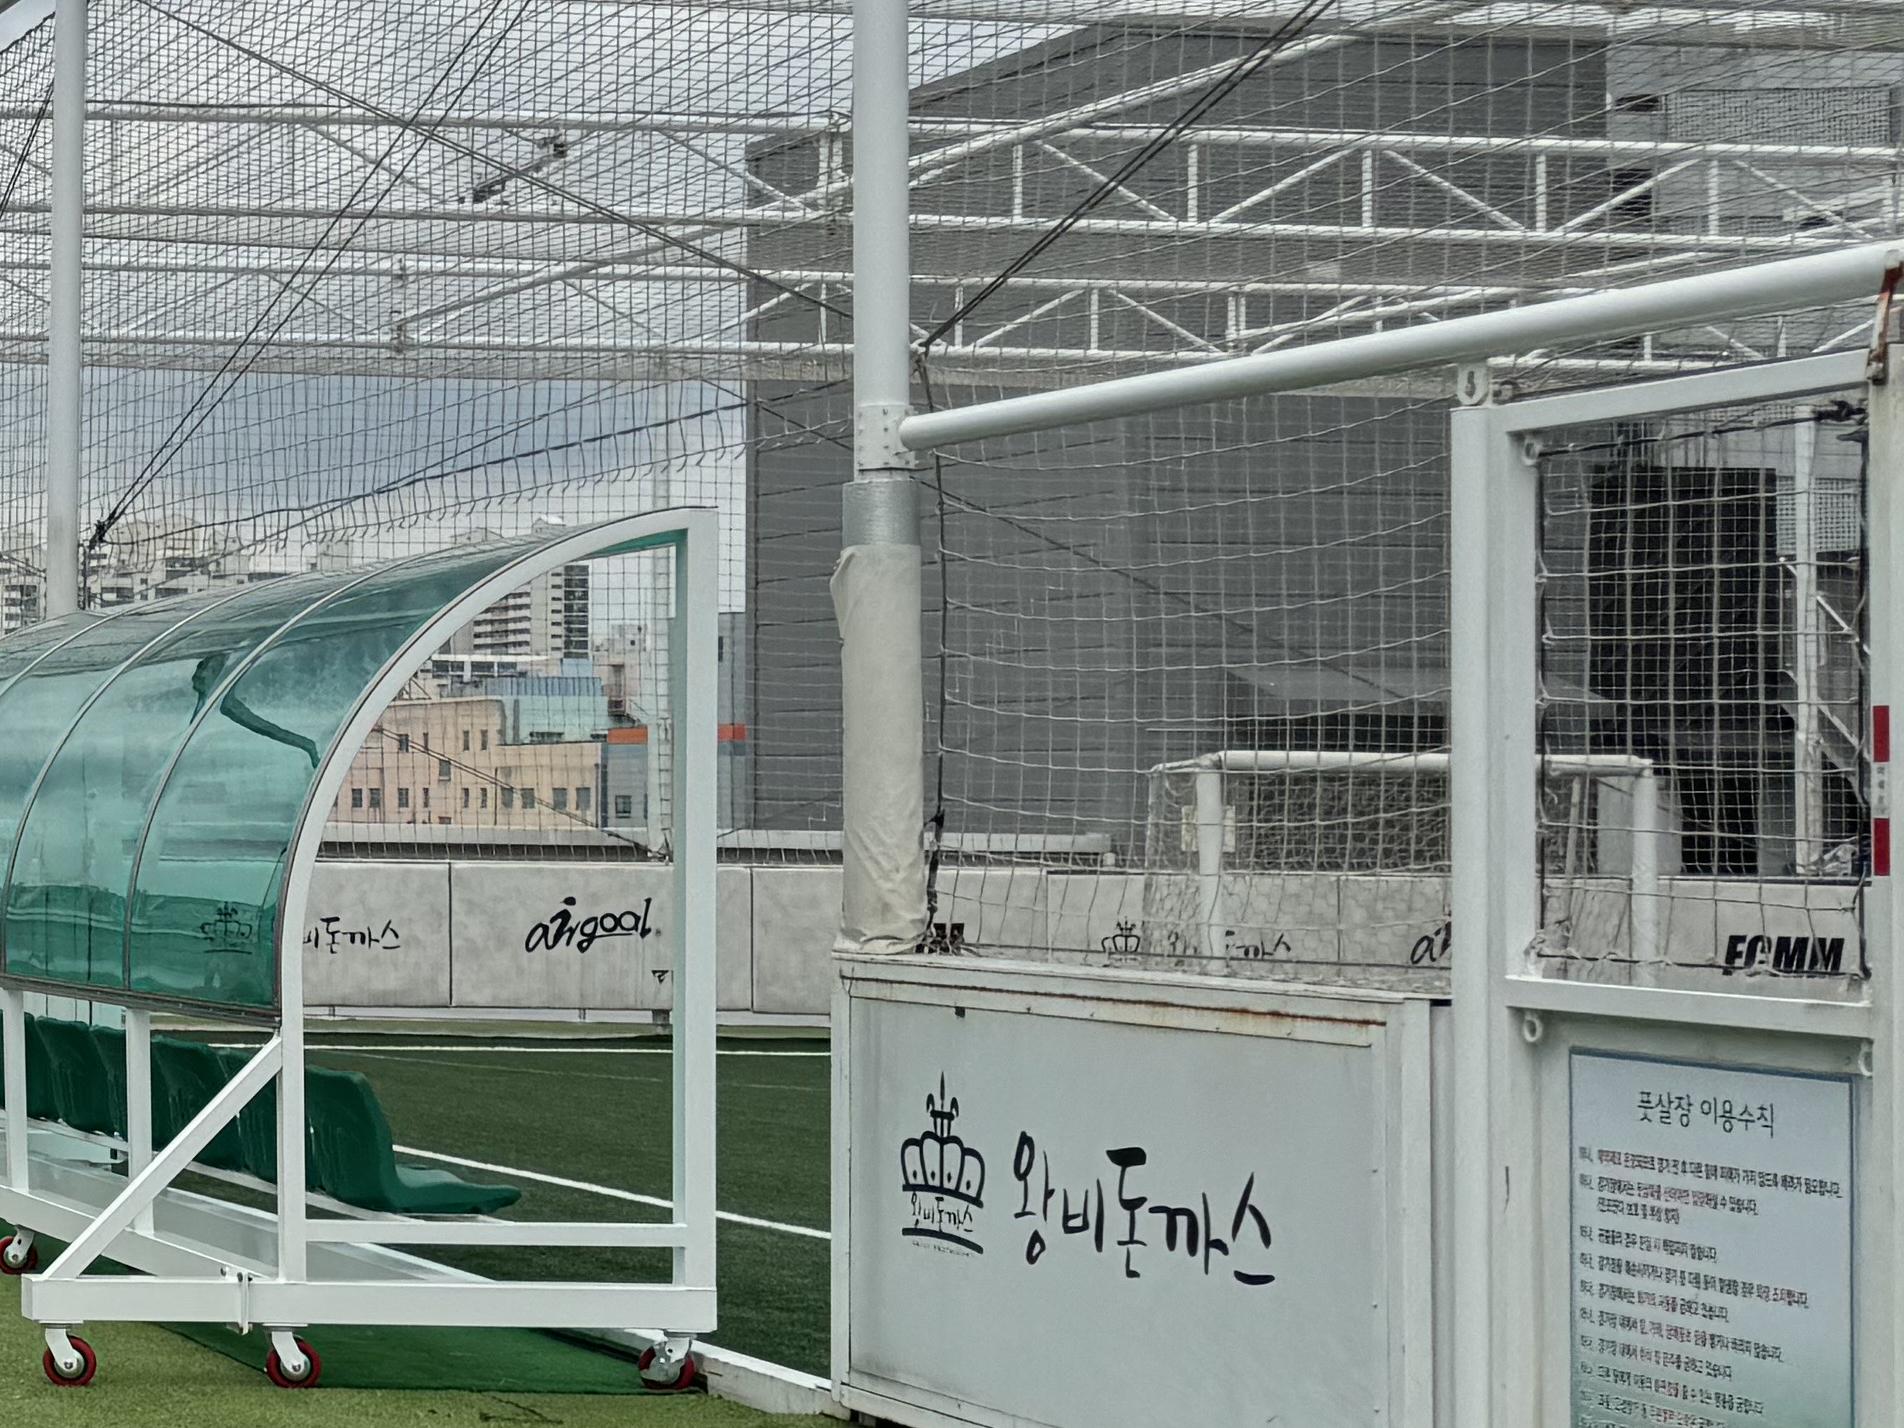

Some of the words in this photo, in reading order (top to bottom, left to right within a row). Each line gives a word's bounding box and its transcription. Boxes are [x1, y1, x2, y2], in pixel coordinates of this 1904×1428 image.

[1722, 934, 1845, 978] FCMM
[1637, 1090, 1694, 1128] 풋살장
[1700, 1096, 1774, 1138] 이용수칙
[911, 1191, 974, 1233] 왕비돈까스
[1014, 1130, 1275, 1286] 왕비돈까스
